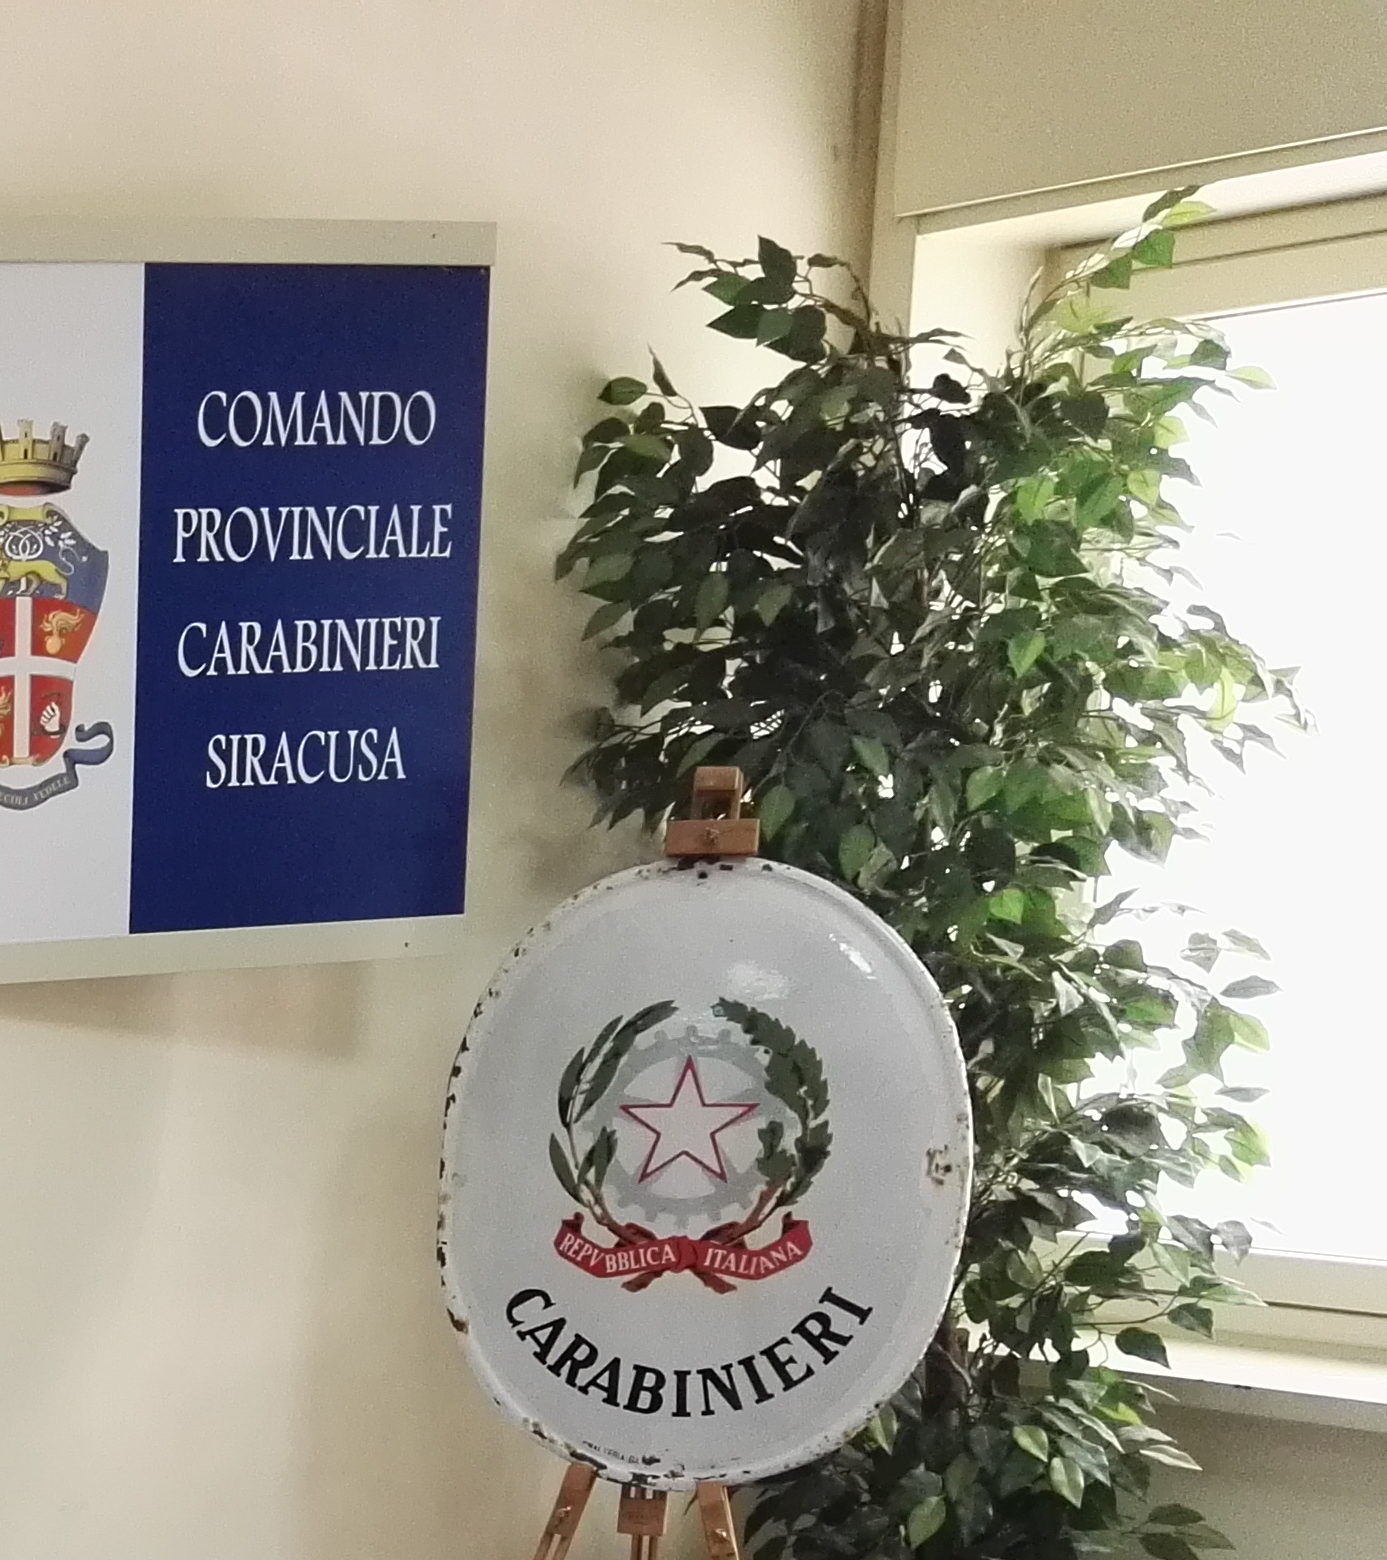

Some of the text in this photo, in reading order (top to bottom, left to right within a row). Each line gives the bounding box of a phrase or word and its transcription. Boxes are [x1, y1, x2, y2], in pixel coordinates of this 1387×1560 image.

[196, 389, 437, 447] COMANDO
[172, 502, 453, 564] PROVINCIALE
[176, 615, 441, 679] CARABINIERI
[205, 725, 407, 790] SIRACUSA
[558, 1232, 803, 1275] REPVBBLICA ITALIANA
[505, 1286, 874, 1418] CARABINIERI
